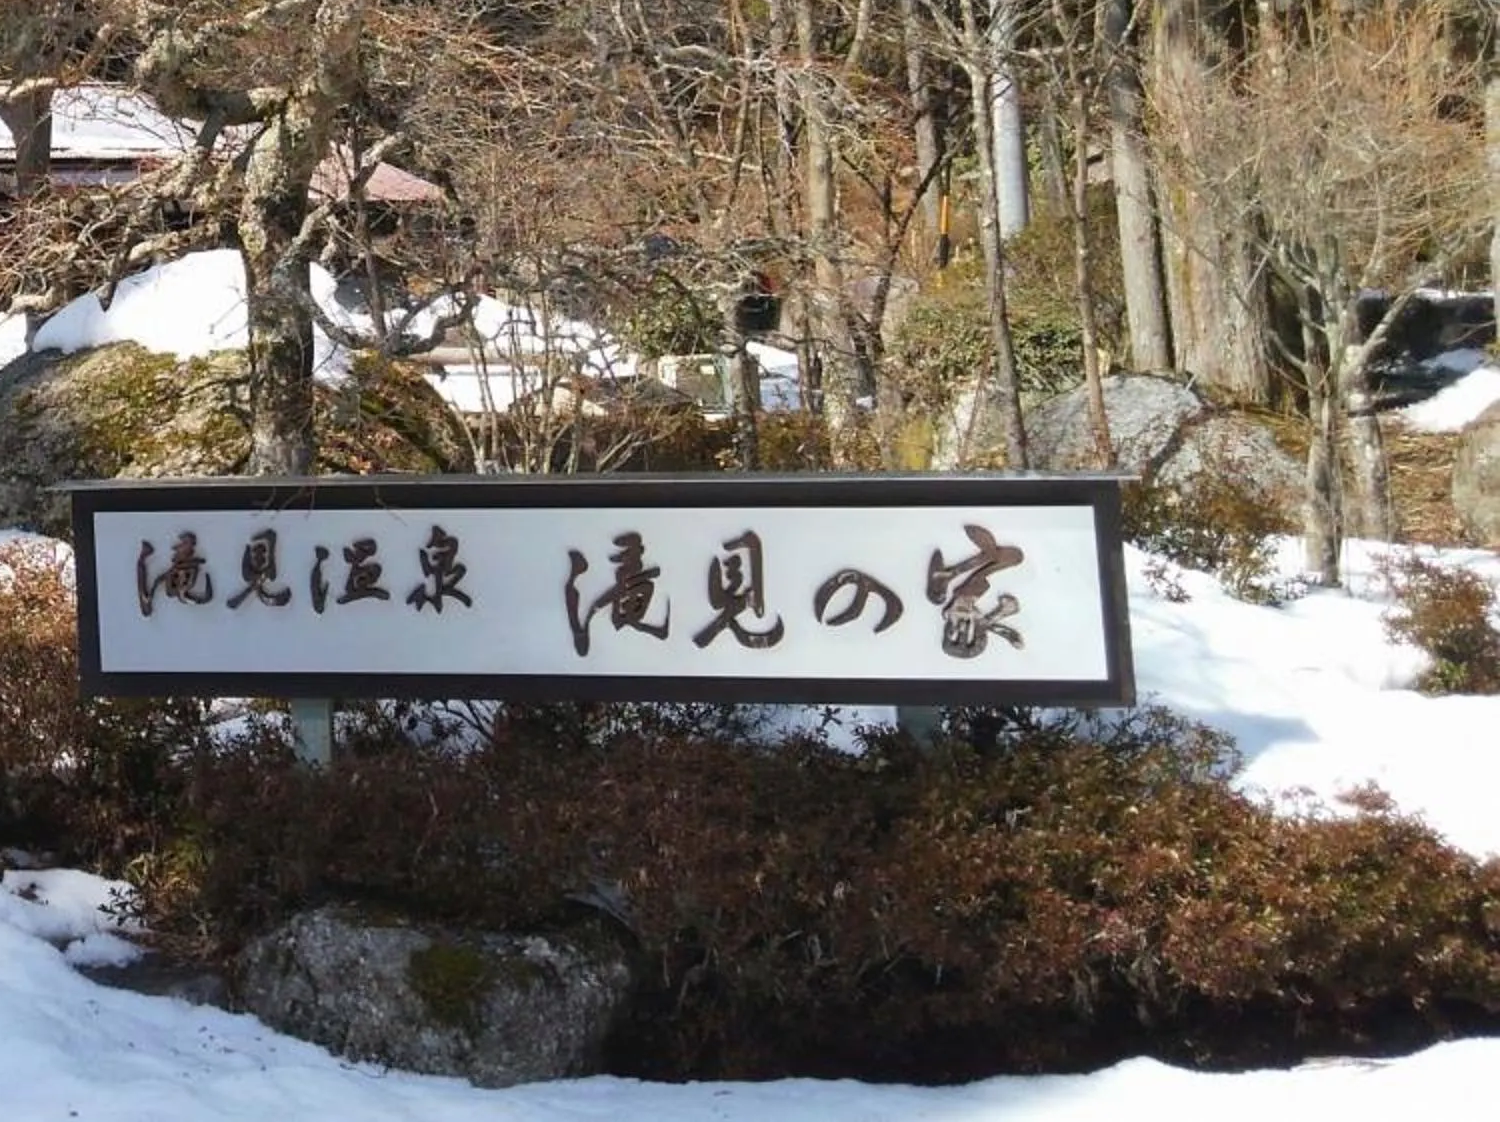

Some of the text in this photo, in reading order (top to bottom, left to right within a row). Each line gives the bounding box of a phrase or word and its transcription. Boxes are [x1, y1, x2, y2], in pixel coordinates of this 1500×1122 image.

[136, 523, 1025, 659] 滝見温泉 滝見の家
